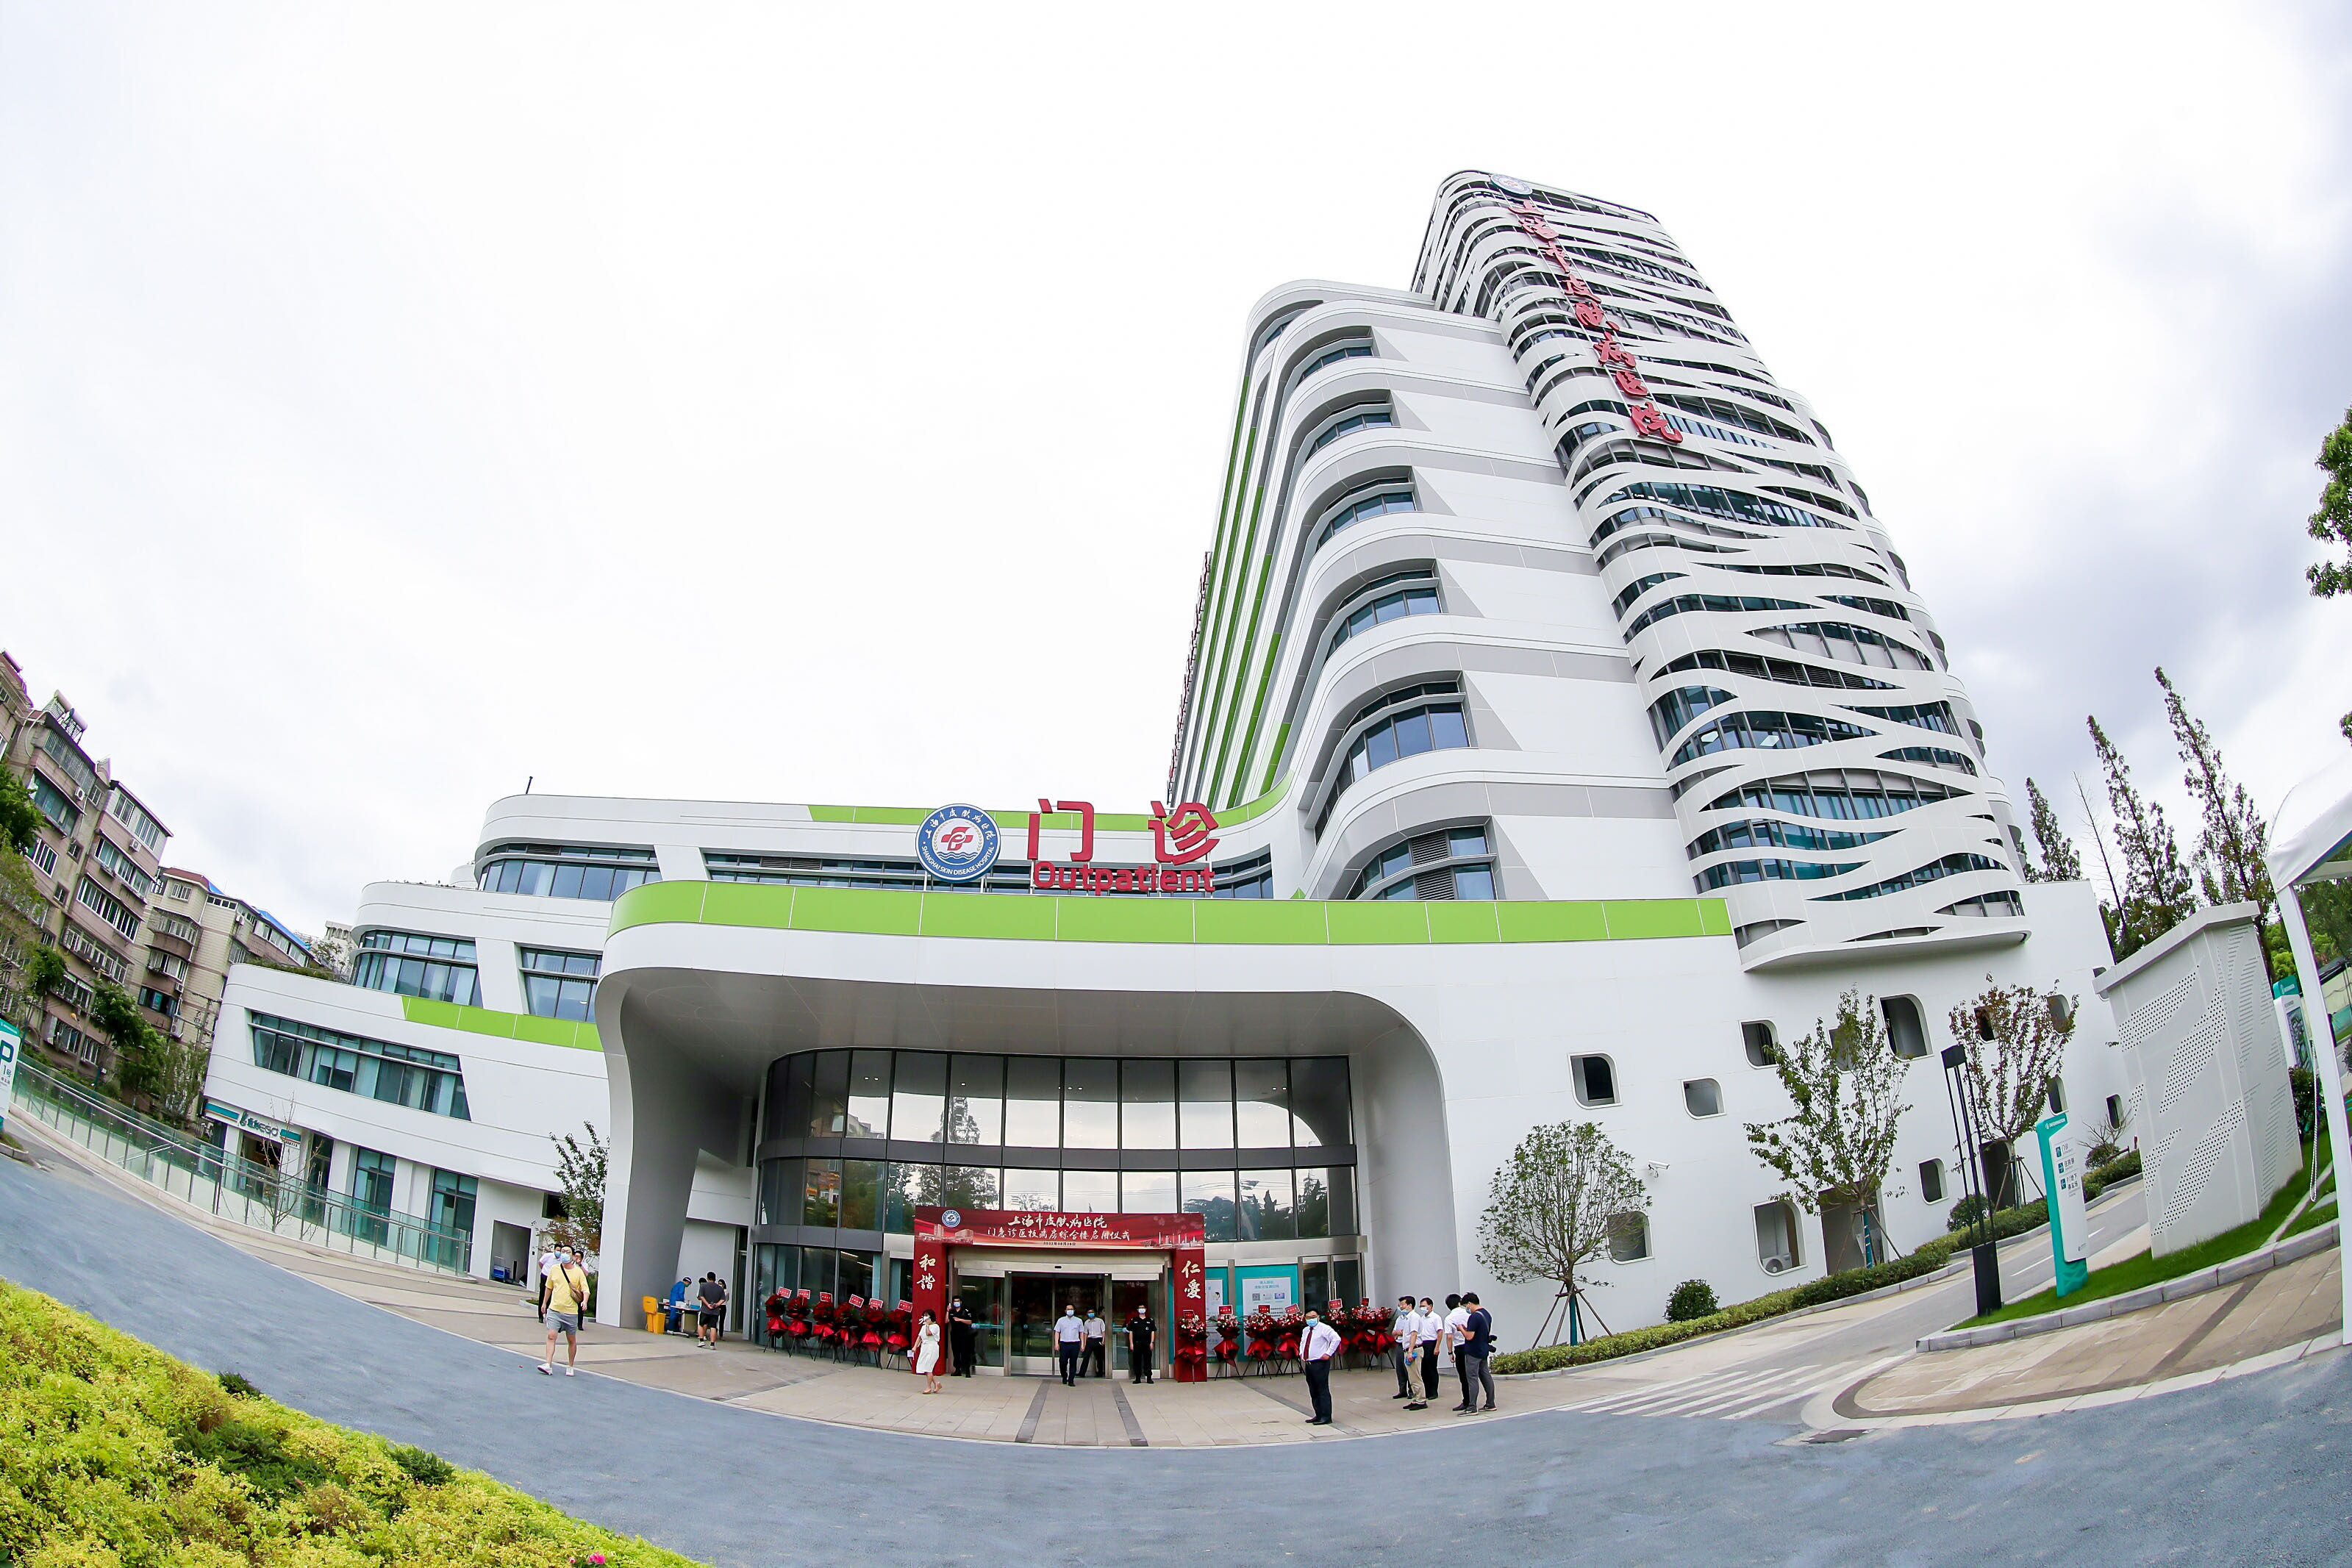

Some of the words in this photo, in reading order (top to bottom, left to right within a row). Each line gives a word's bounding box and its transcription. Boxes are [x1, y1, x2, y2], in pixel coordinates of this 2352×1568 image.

[1508, 200, 1683, 444] 上海市皮肤病医院
[1027, 798, 1220, 866] 门诊
[921, 845, 940, 870] SHANGHAI
[939, 865, 954, 875] SKIN
[953, 865, 977, 876] DISEASE
[976, 846, 995, 869] HOSPITAL
[1034, 861, 1215, 896] Outpatient
[987, 1227, 1130, 1241] 门急诊医技病房综合楼启用仪式
[1008, 1213, 1108, 1230] 上海市皮肤病医院
